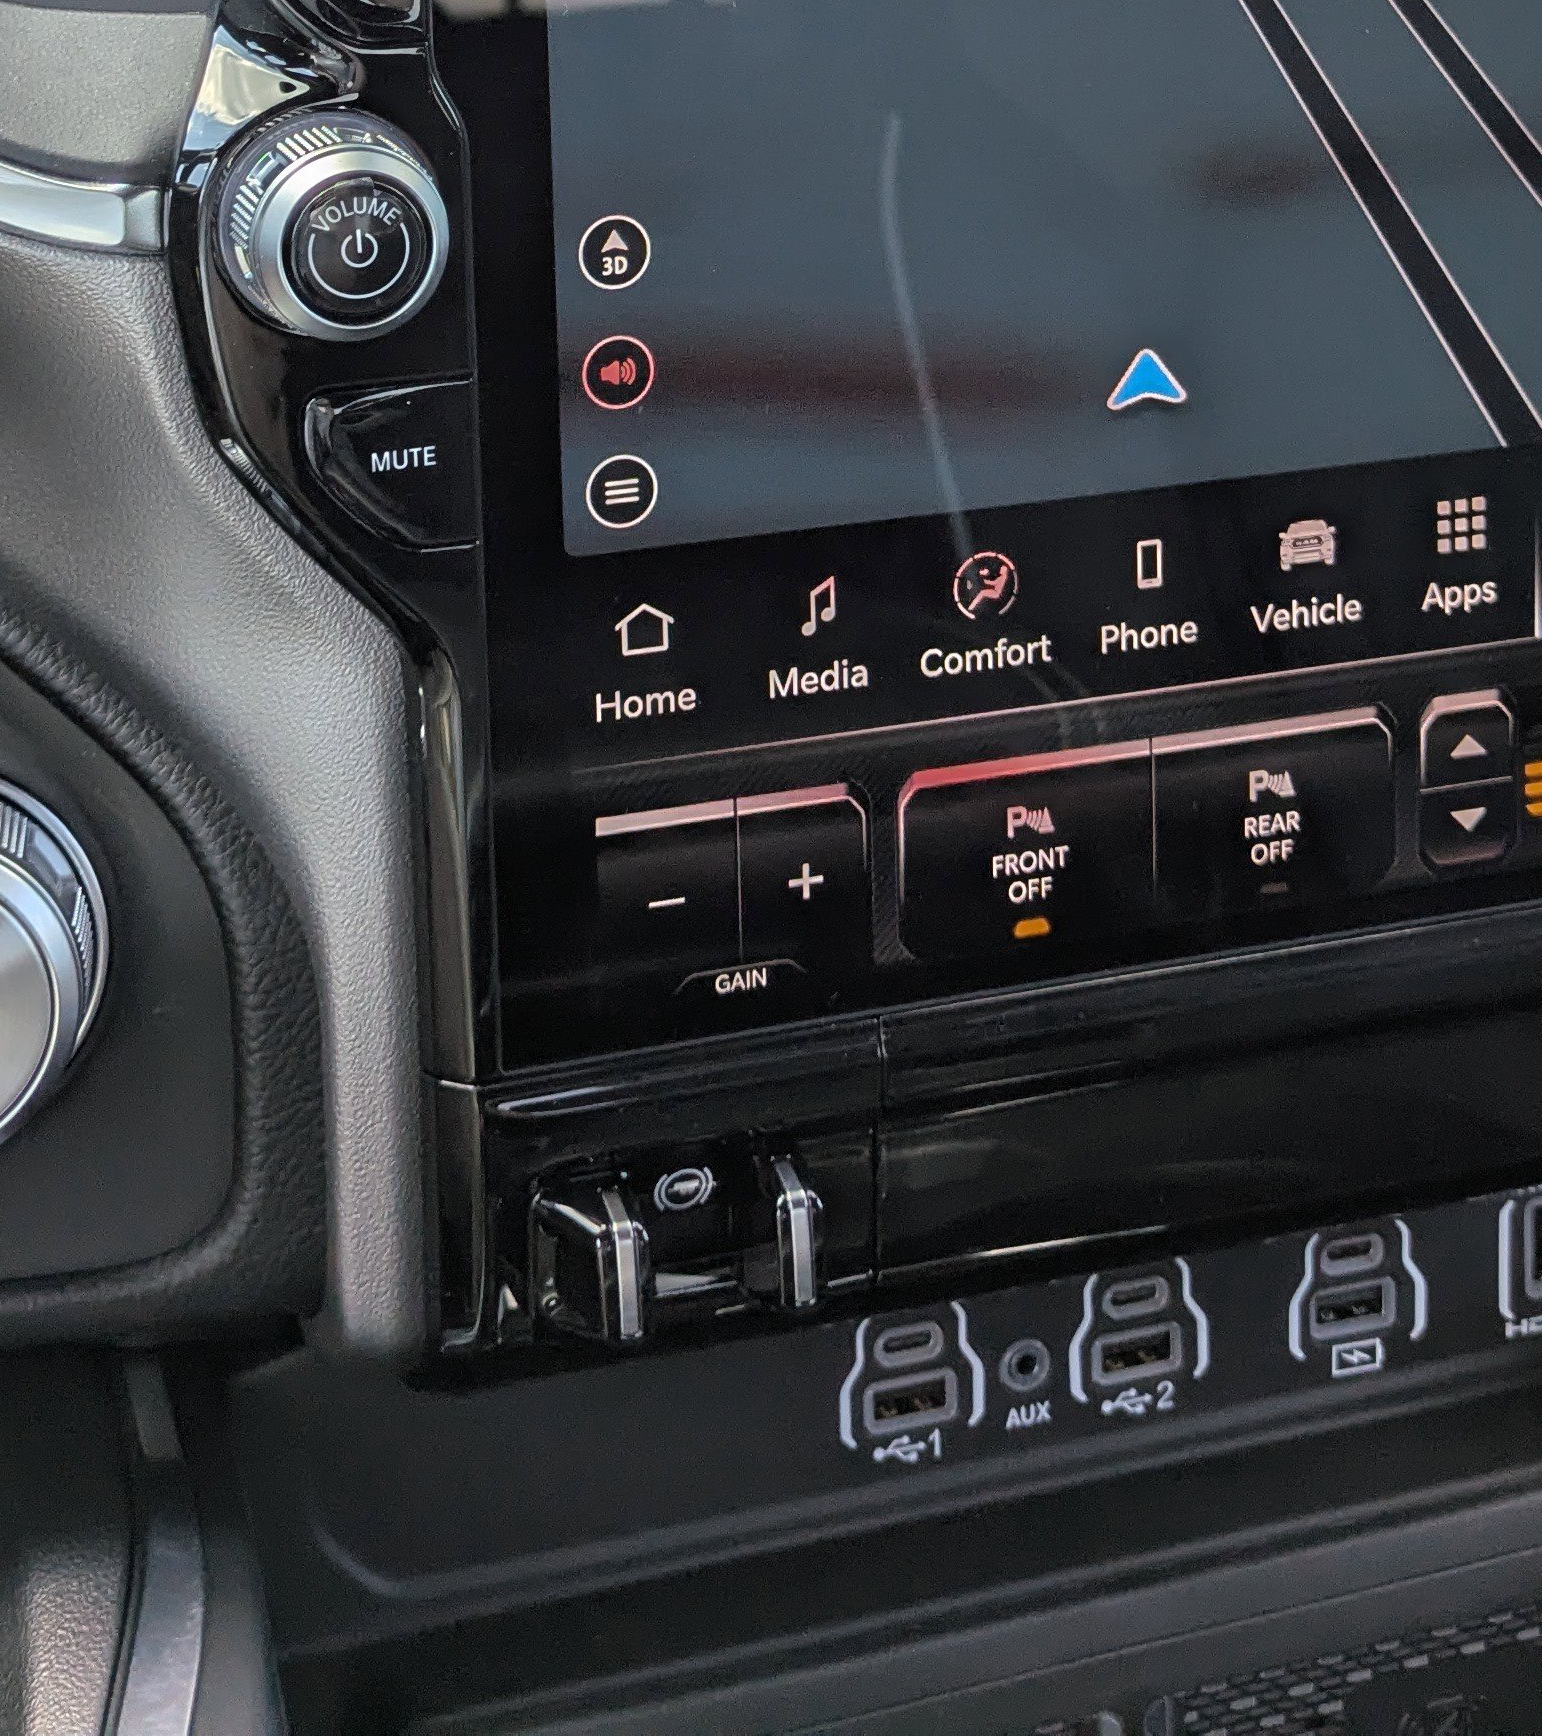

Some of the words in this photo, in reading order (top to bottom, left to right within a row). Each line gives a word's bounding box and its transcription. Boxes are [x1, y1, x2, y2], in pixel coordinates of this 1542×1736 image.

[311, 196, 403, 234] VOLUME
[601, 255, 628, 276] 3D
[371, 445, 437, 473] MUTE
[1421, 578, 1498, 616] Apps
[1250, 593, 1362, 633] Vehicle
[1100, 617, 1199, 655] Phone
[921, 634, 1052, 679] Comfort
[769, 660, 870, 700] Media
[595, 684, 697, 723] Home
[1244, 809, 1300, 840] REAR
[991, 844, 1070, 880] FRONT
[1250, 837, 1294, 865] OFF
[1008, 876, 1053, 905] OFF
[715, 966, 767, 996] GAIN
[1156, 1380, 1176, 1410] 2
[1005, 1400, 1052, 1430] AUX
[928, 1428, 942, 1459] 1
